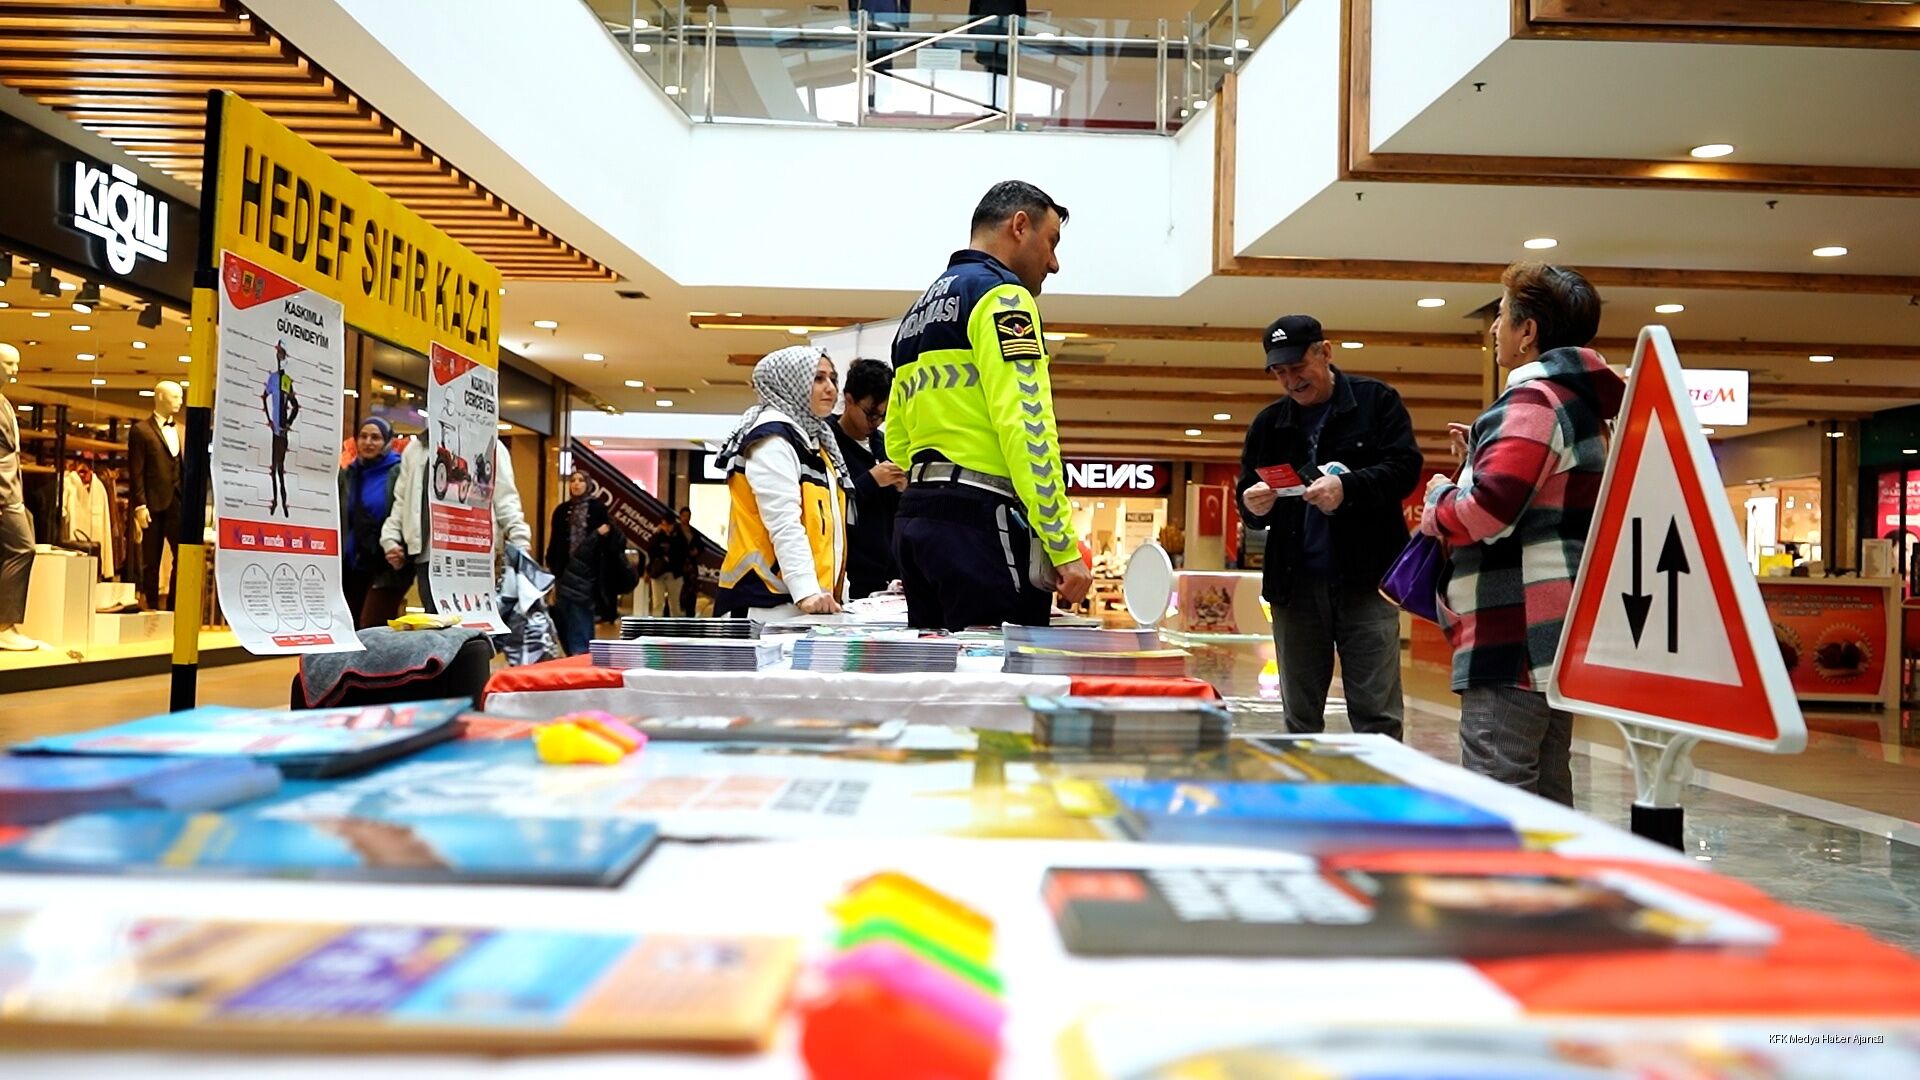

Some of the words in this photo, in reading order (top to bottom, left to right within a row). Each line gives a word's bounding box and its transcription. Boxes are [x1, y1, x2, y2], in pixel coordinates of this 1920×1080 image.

[240, 145, 356, 282] HEDEF
[361, 218, 429, 322] SIFIR
[434, 260, 491, 353] KAZA
[284, 299, 325, 328] KASKIMLA
[276, 317, 329, 349] GÜVENDEYİM
[1065, 462, 1155, 490] NEVAS
[620, 502, 660, 534] PREMIUM
